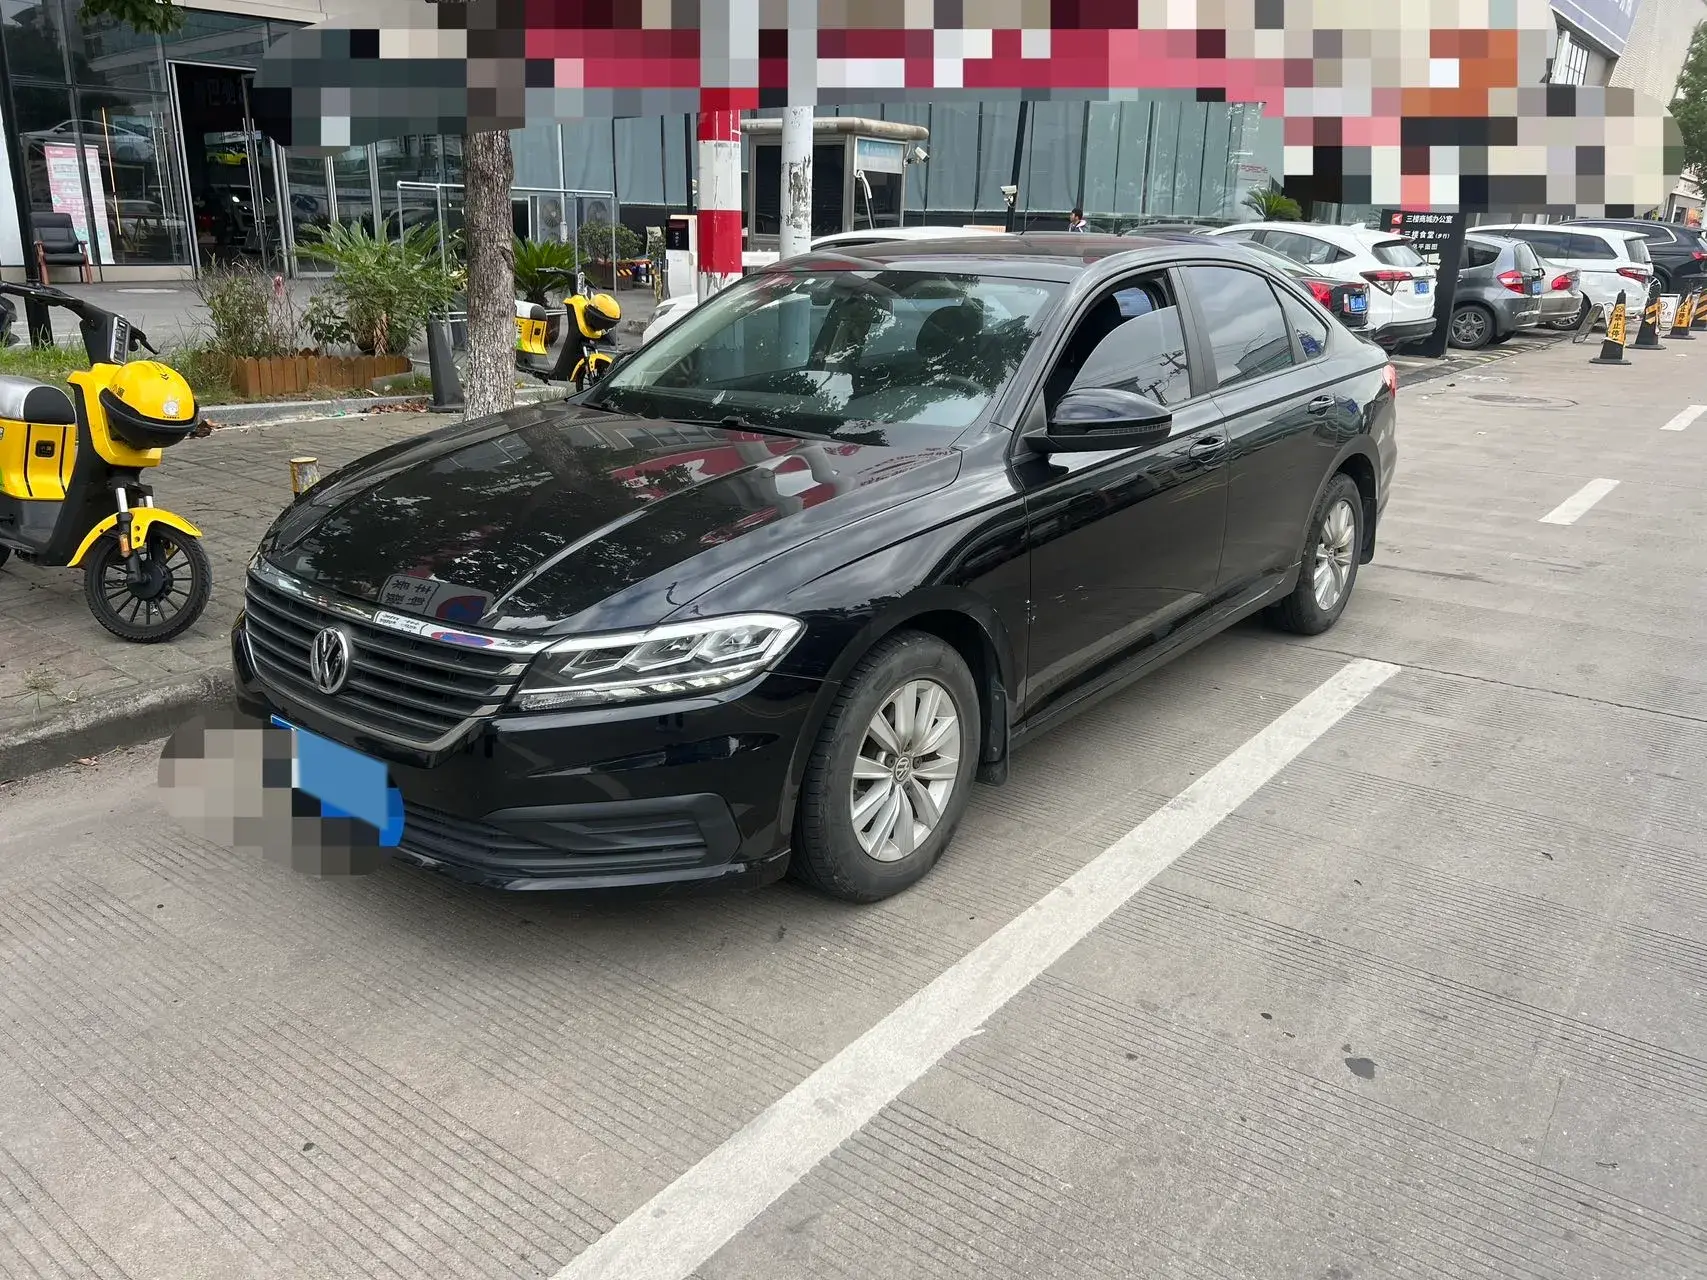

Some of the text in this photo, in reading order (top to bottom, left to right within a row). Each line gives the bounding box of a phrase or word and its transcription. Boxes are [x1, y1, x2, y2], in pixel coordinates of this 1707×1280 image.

[1405, 215, 1453, 224] 三楼商城办公室
[1611, 313, 1622, 340] 禁止停
